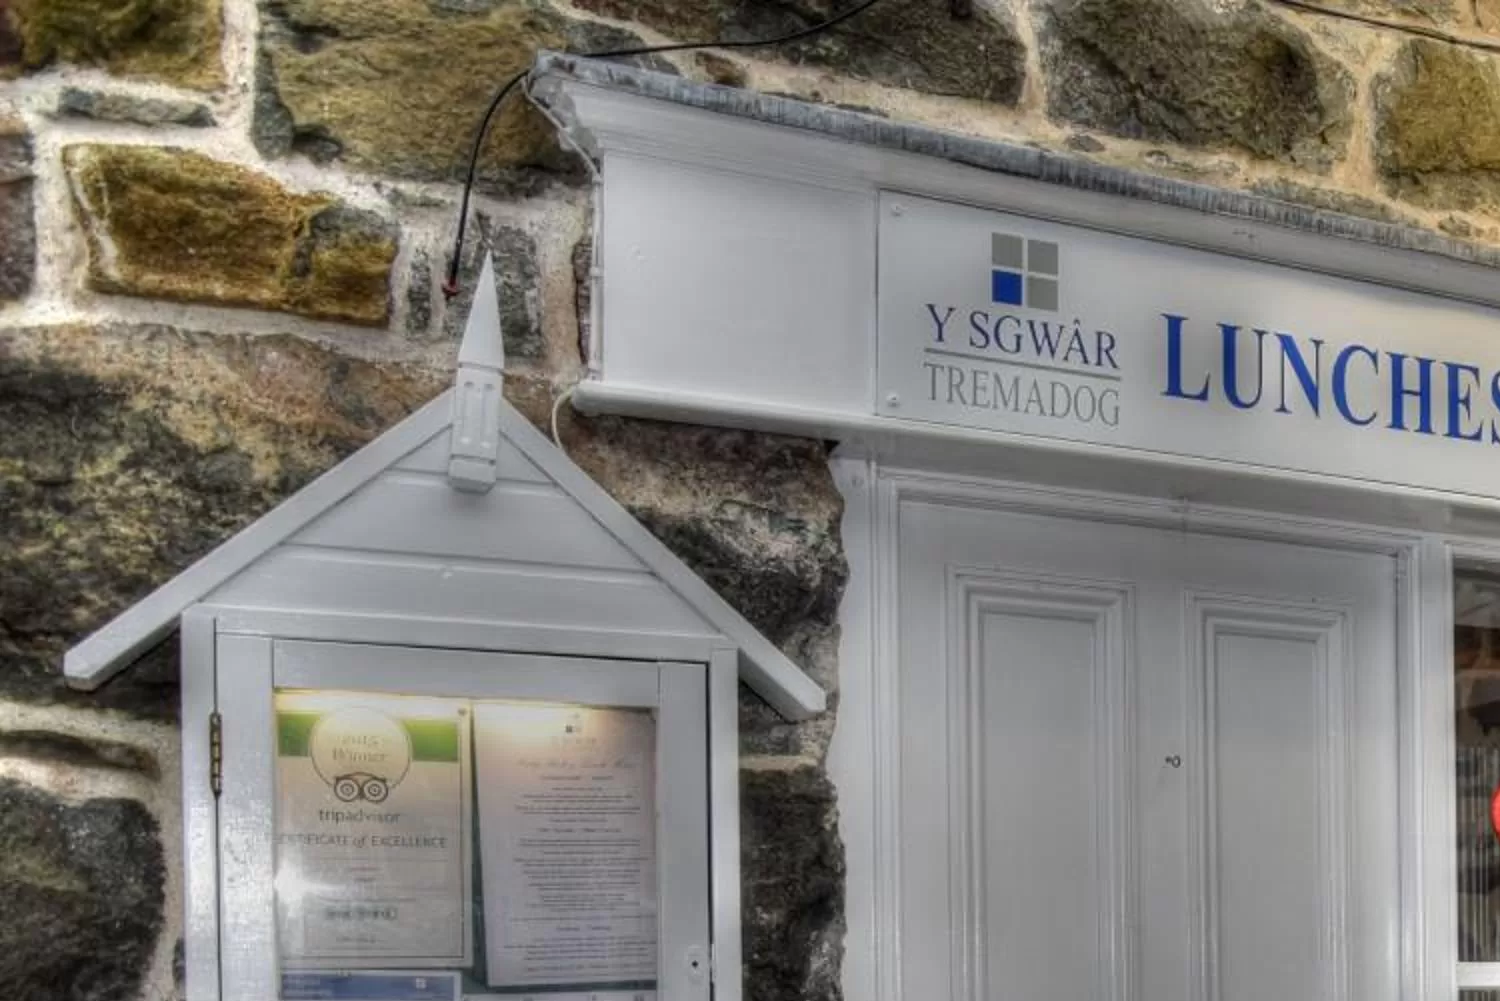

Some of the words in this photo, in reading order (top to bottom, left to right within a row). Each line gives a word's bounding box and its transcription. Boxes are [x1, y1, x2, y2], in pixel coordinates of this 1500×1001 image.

[925, 303, 956, 343] Y
[968, 310, 1121, 370] SGWÂR
[923, 361, 1121, 427] TREMADOG
[318, 808, 401, 824] tripadvisor
[371, 835, 448, 849] EXCELLENCE
